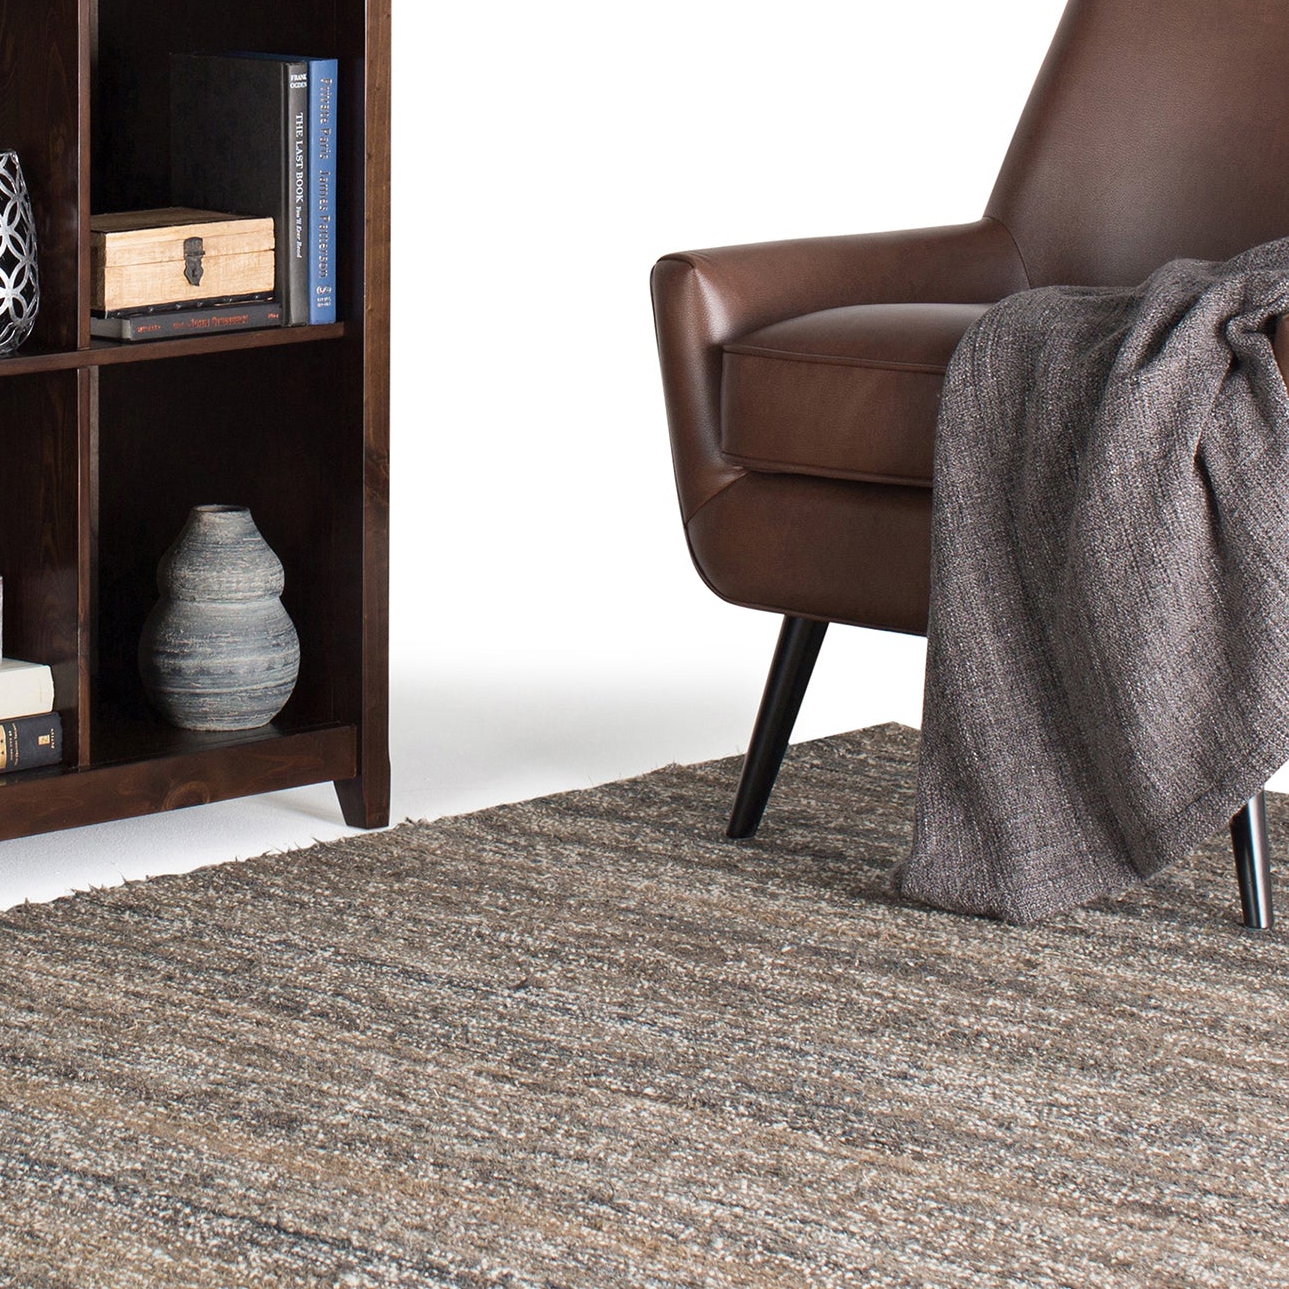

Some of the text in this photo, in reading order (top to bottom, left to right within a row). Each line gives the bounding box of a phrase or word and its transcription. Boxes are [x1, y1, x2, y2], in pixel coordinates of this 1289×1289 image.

[290, 73, 307, 81] FRANK
[290, 81, 307, 89] OGDEN
[295, 112, 304, 203] THE LAST BOOK
[318, 78, 332, 160] Private Paris
[318, 170, 331, 279] James Patterson
